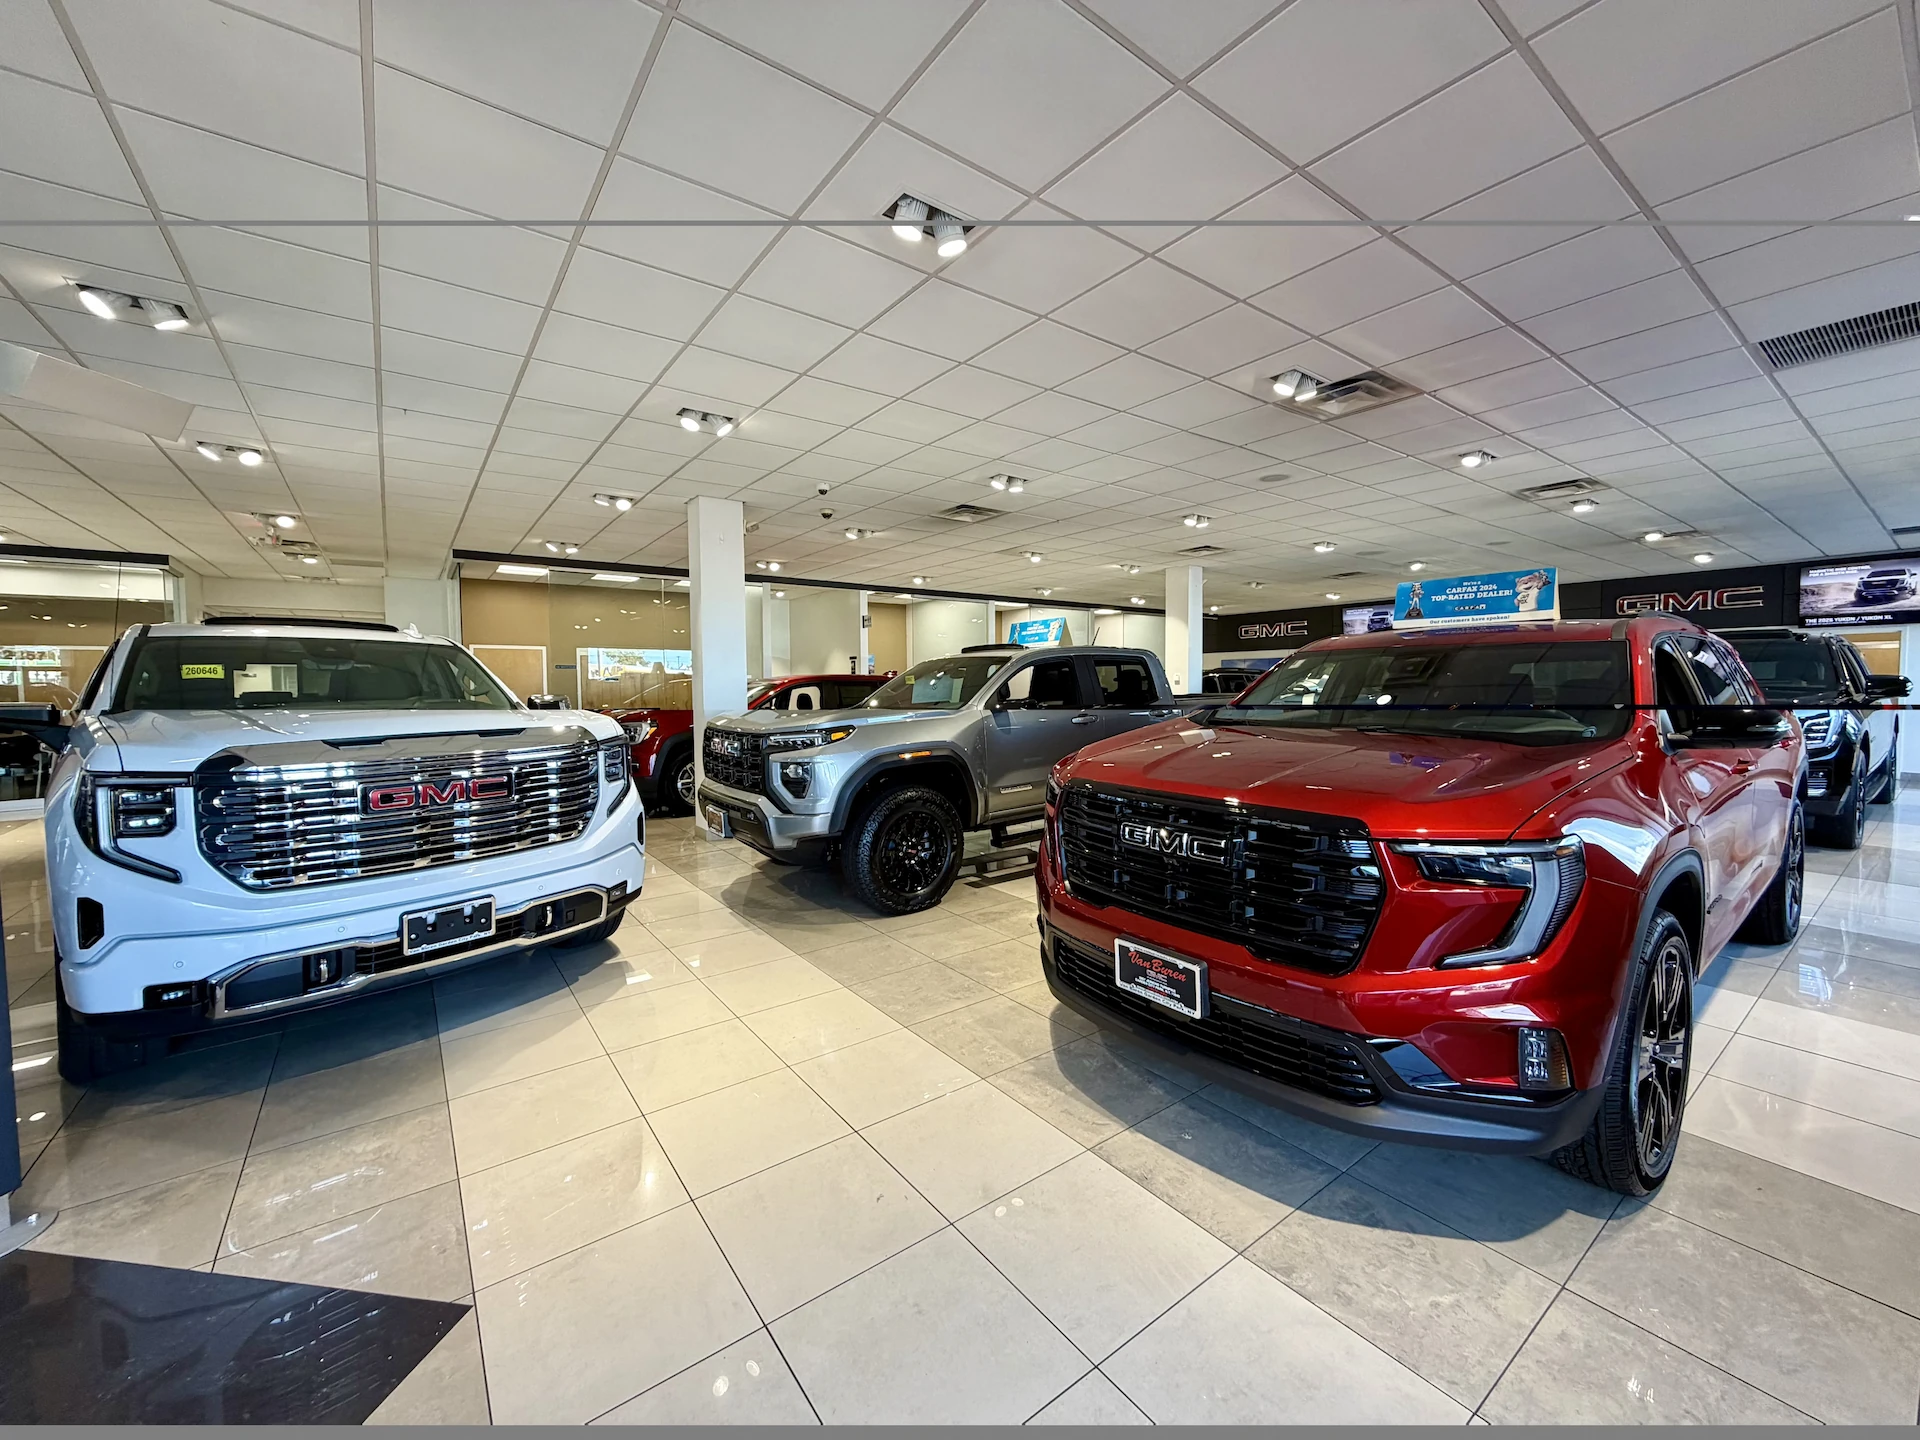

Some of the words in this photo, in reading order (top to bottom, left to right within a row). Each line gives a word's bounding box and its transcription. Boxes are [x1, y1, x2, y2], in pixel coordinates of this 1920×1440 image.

[1431, 593, 1475, 602] TOP-RATED
[1476, 589, 1513, 598] DEALER!
[1446, 585, 1478, 594] CARFAX
[1479, 583, 1497, 591] 2024
[1616, 585, 1764, 616] GMC
[1238, 620, 1308, 640] GMC
[185, 667, 218, 675] 260646
[710, 738, 741, 757] GMC
[369, 775, 508, 811] GMC
[1120, 821, 1226, 865] GMC
[1151, 959, 1187, 982] Buren
